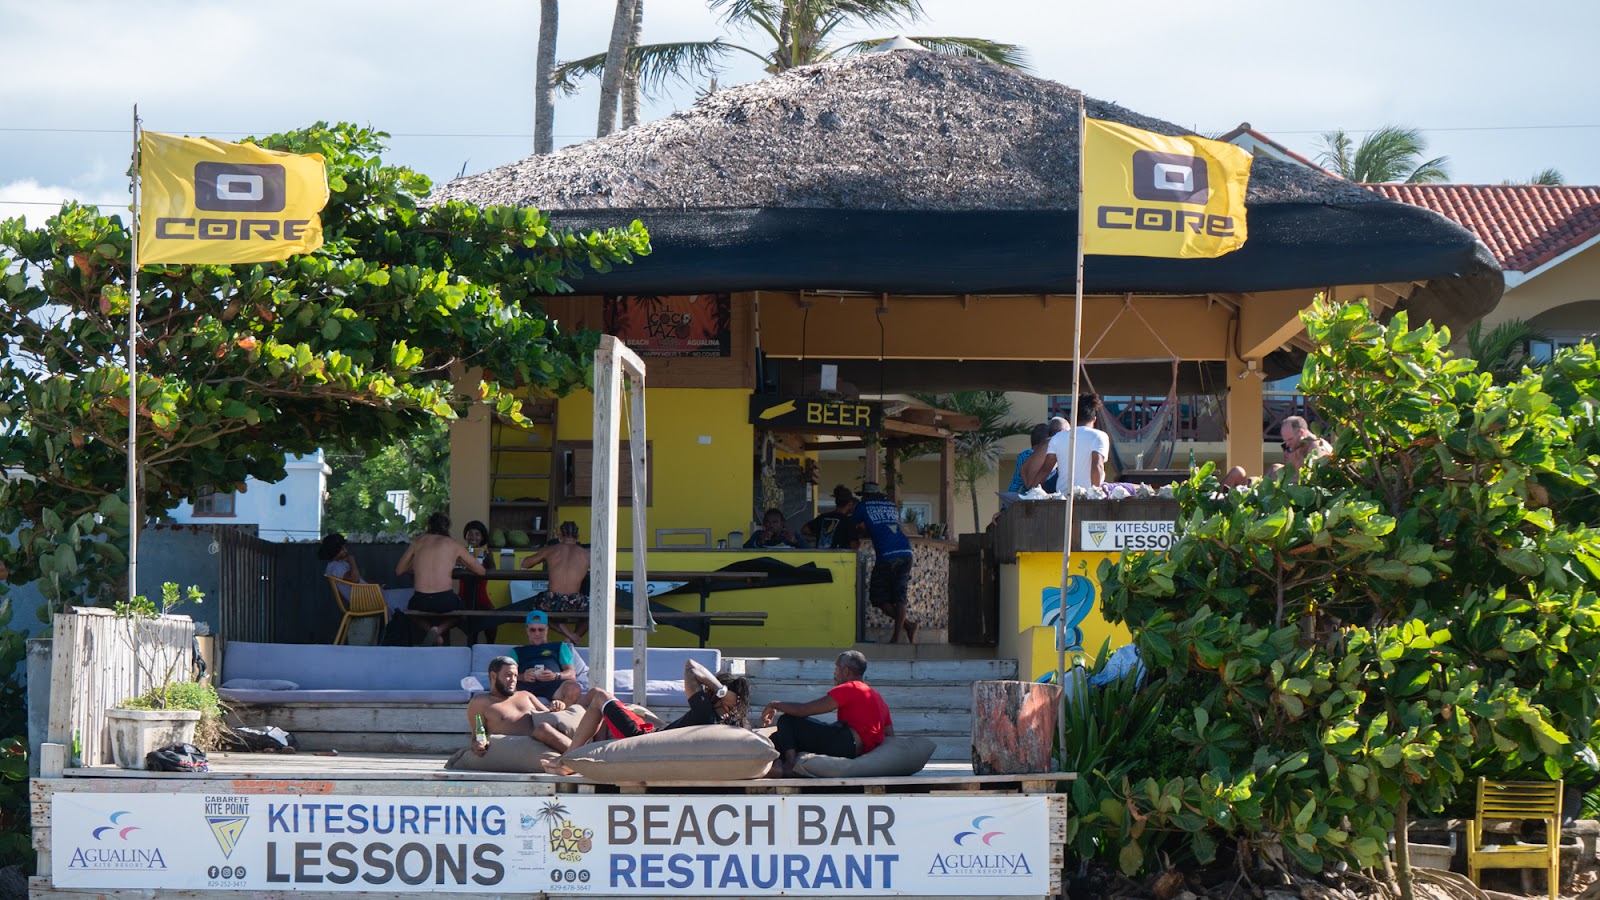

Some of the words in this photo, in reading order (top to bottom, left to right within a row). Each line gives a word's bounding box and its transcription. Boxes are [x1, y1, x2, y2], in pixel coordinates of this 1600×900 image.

[806, 402, 871, 427] BEER
[1115, 523, 1173, 533] KITESURF
[1115, 535, 1181, 548] LESSON
[205, 803, 223, 815] KITE
[225, 803, 250, 815] POINT
[268, 803, 506, 836] KITESURFING
[607, 803, 776, 846] BEACH
[797, 804, 896, 846] BAR
[68, 847, 168, 869] AGUALINA
[266, 841, 505, 886] LESSONS
[928, 852, 1033, 875] AGUALINA
[609, 853, 900, 889] RESTAURANT
